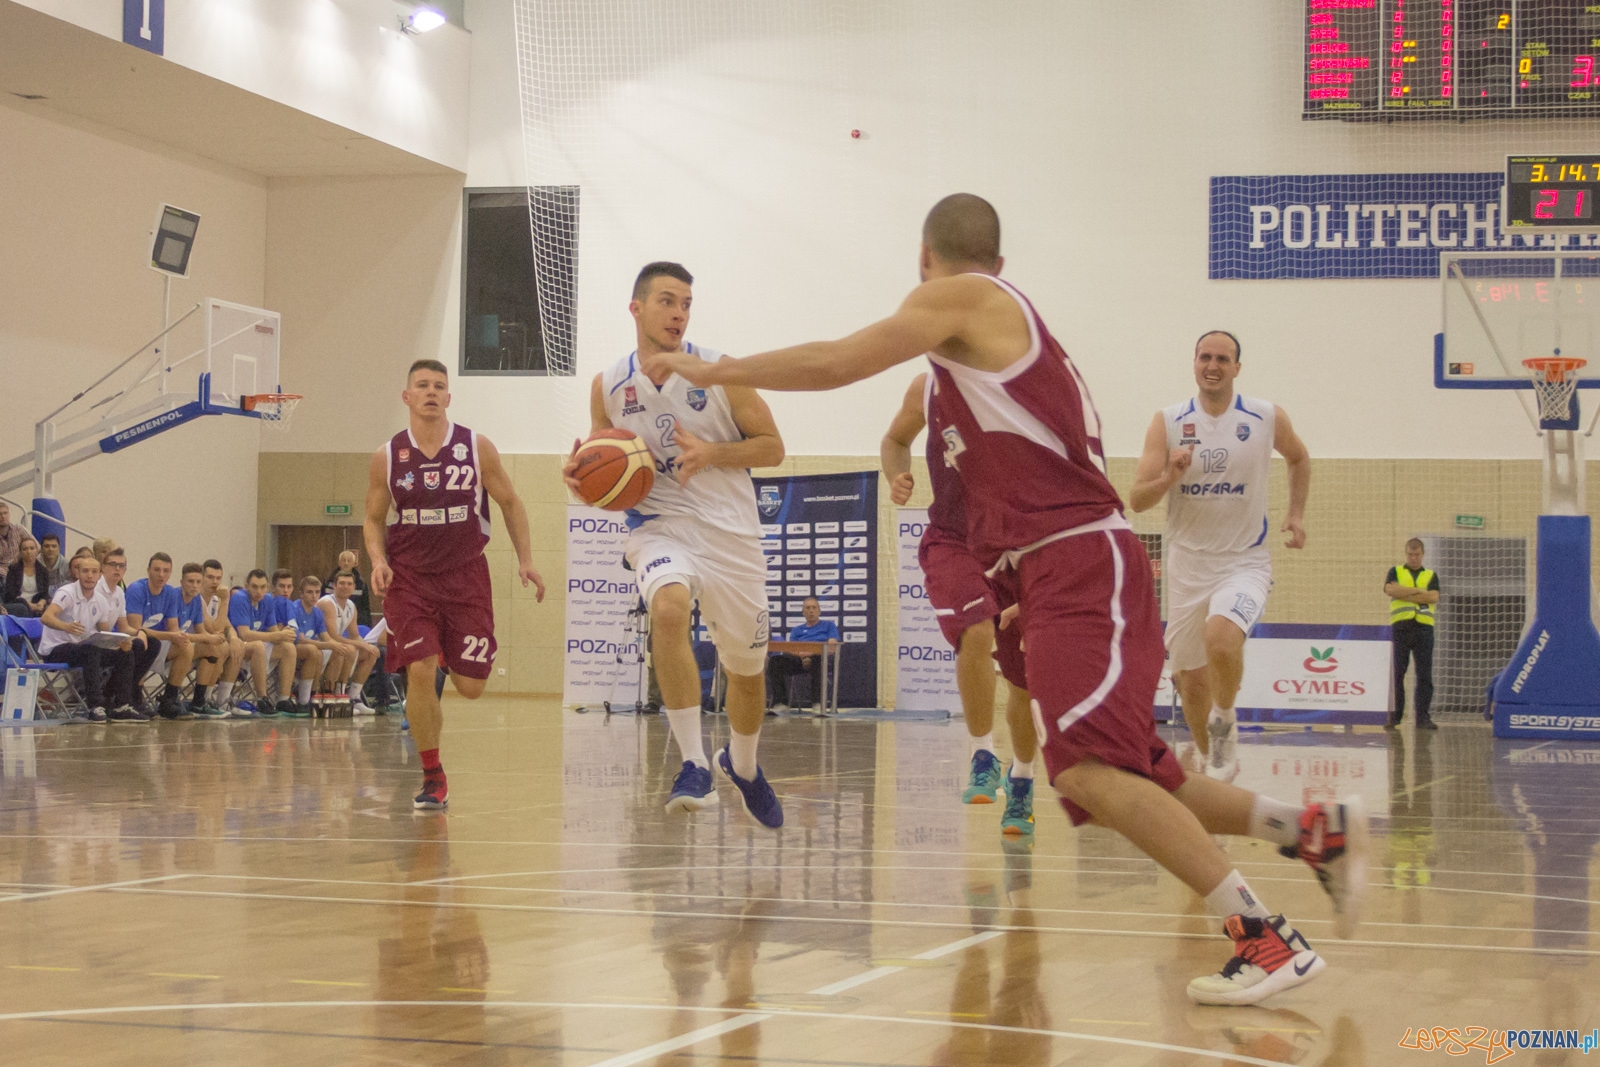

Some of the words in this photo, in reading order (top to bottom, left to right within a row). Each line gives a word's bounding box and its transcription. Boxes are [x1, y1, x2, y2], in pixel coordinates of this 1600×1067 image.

[1497, 13, 1510, 30] 2
[1519, 58, 1532, 74] 0
[1534, 189, 1585, 219] 21
[114, 410, 183, 443] PESMENPOL
[655, 413, 677, 448] 2
[1199, 448, 1229, 474] 12
[445, 464, 475, 491] 22
[645, 556, 671, 573] PBG
[460, 635, 490, 663] 22
[1511, 629, 1550, 694] HYDROPLAY
[1272, 679, 1366, 696] CYMES
